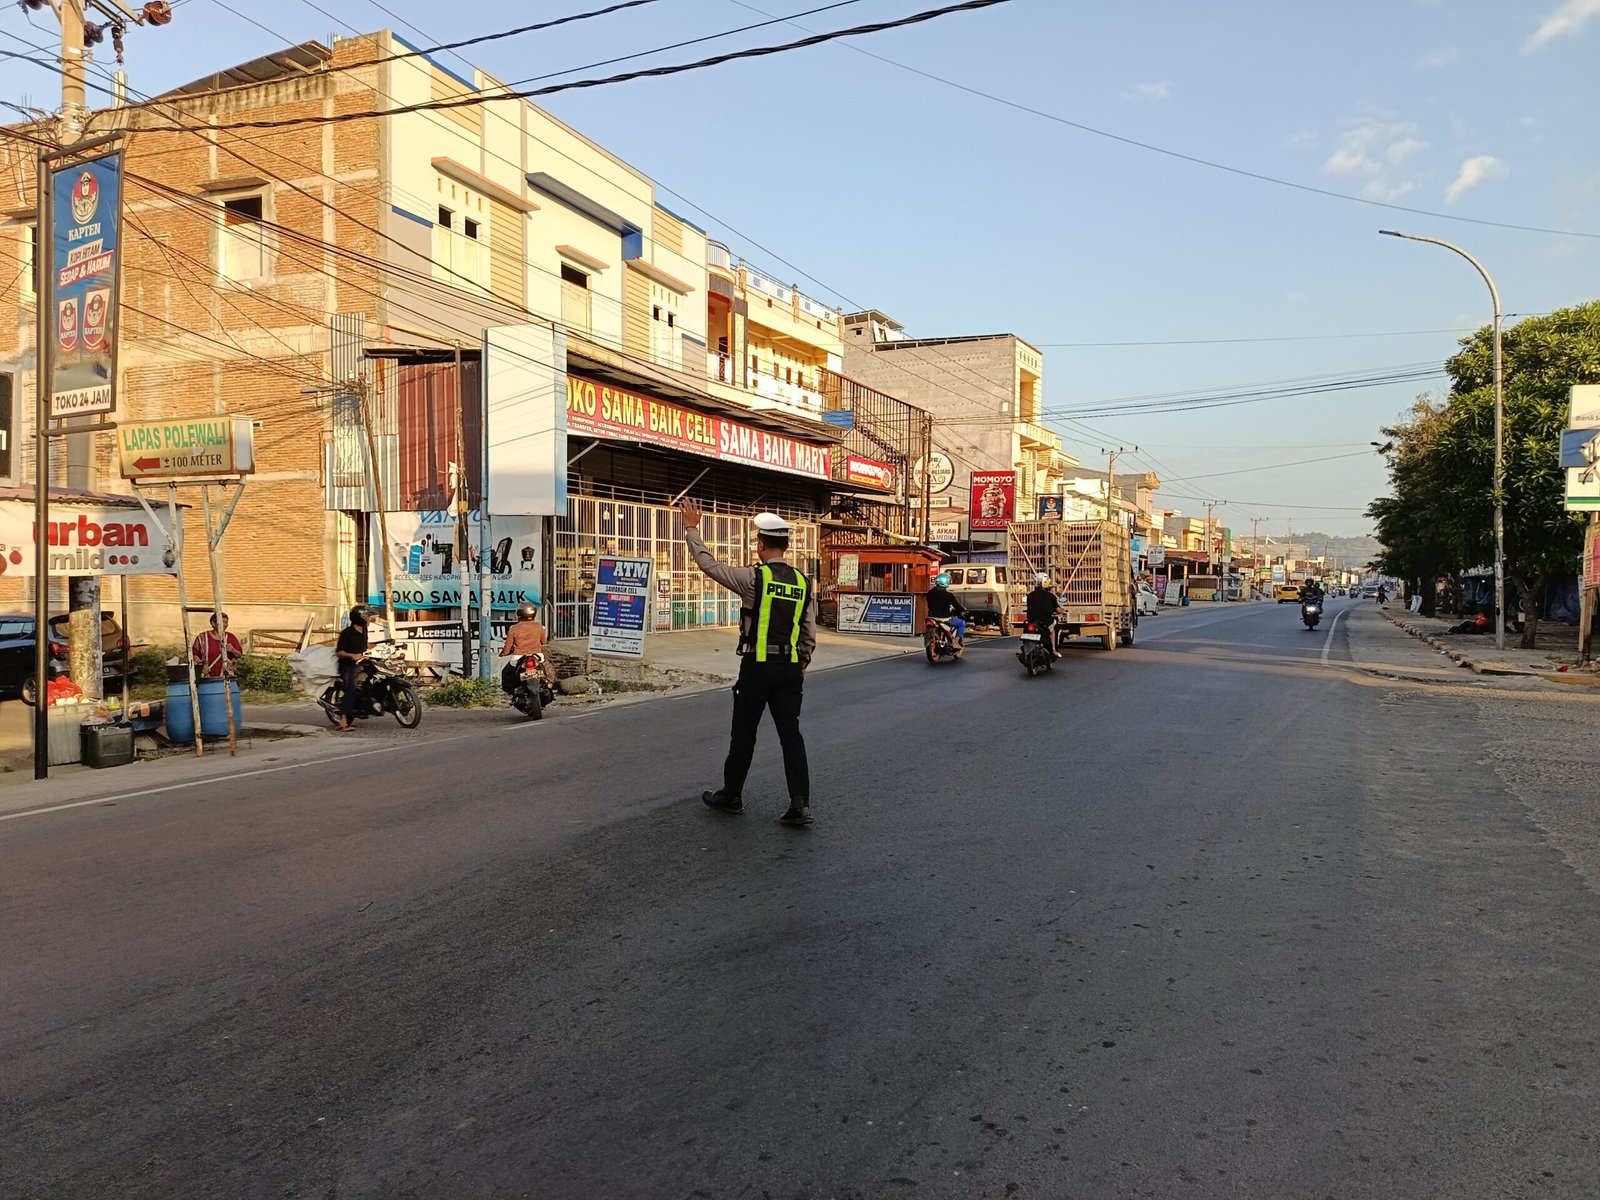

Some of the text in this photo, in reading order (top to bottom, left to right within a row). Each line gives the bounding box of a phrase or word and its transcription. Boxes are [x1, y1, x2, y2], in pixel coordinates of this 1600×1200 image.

[68, 222, 101, 241] KAPTEN
[79, 264, 87, 279] &
[86, 254, 111, 275] HARUM
[55, 389, 110, 410] TOKO 24 JAM
[601, 387, 646, 430] SAMA
[649, 401, 683, 438] BAIK
[686, 412, 717, 446] CELL
[122, 422, 227, 451] LAPAS POLEWALI
[720, 421, 760, 460] SAMA
[763, 433, 792, 467] BAIK
[795, 444, 828, 475] MART
[172, 456, 188, 468] 100
[190, 453, 222, 467] METER
[973, 475, 1012, 484] MOMOYO
[50, 548, 106, 570] mild
[613, 561, 649, 578] ATM
[380, 590, 424, 604] TOKO
[767, 583, 804, 600] POLISI
[872, 597, 912, 606] SAMA BAIK
[415, 626, 473, 638] Accesori
